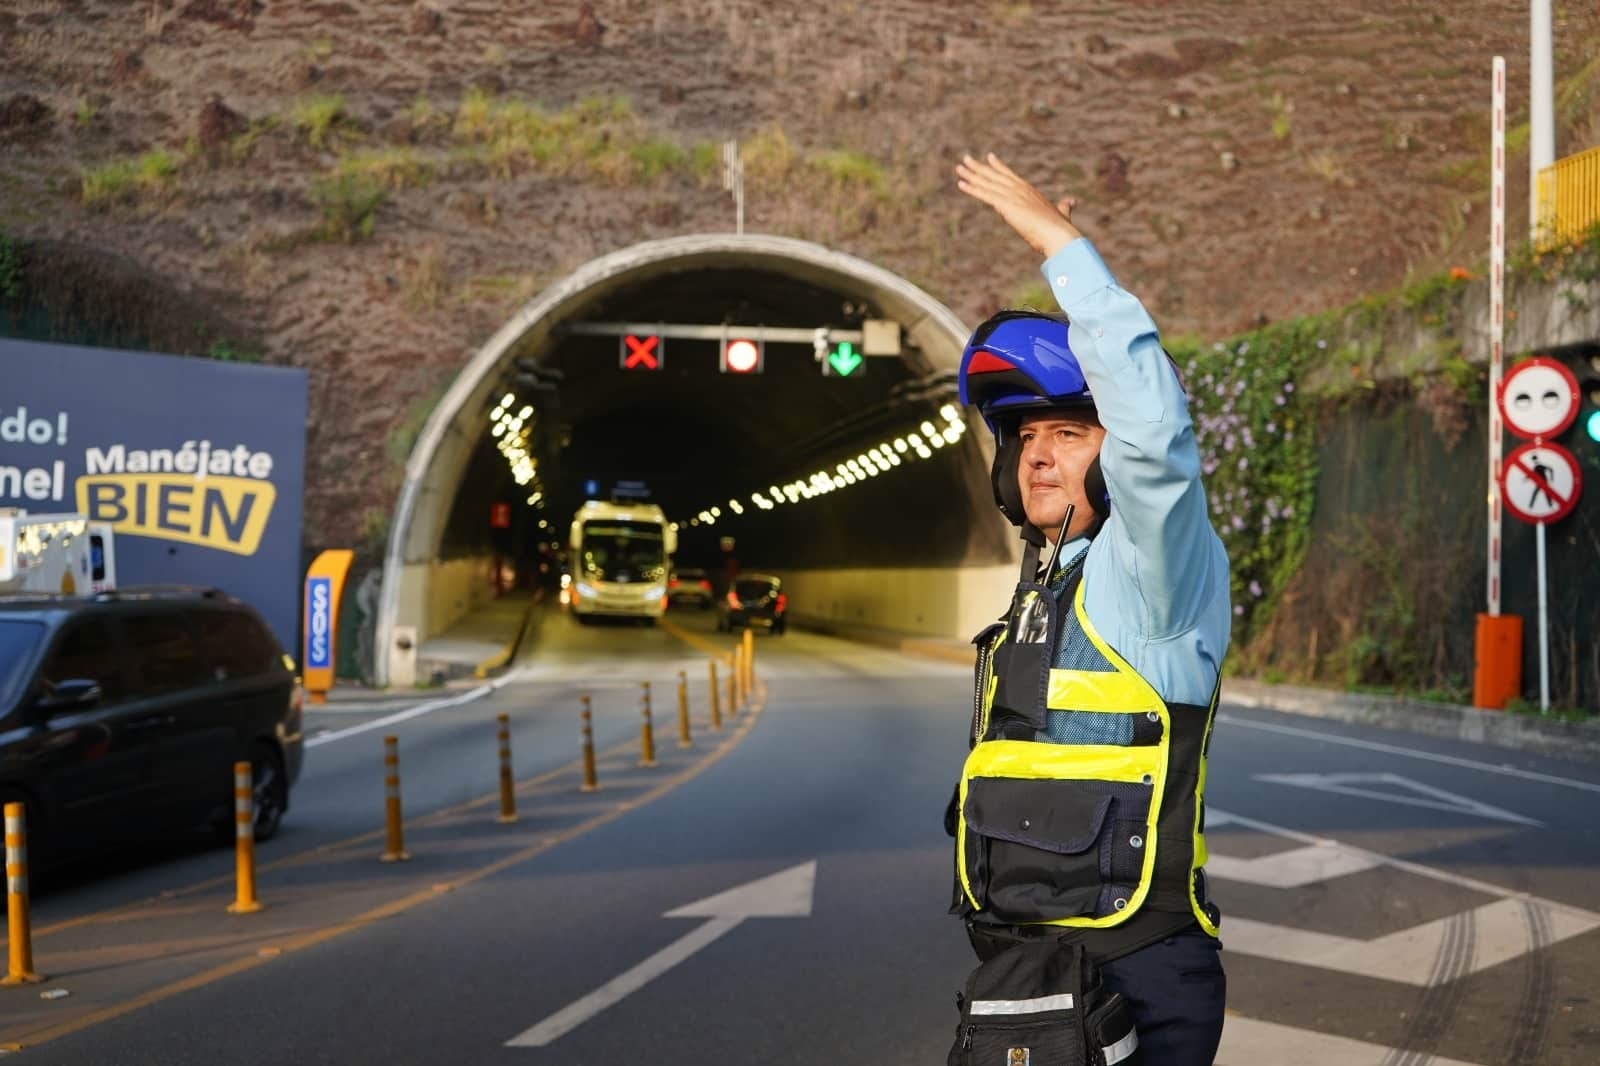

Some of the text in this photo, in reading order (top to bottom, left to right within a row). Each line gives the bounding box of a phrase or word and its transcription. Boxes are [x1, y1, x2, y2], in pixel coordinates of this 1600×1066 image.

[85, 439, 273, 482] Manéjate
[87, 482, 257, 544] BIEN
[312, 583, 328, 662] SOS
